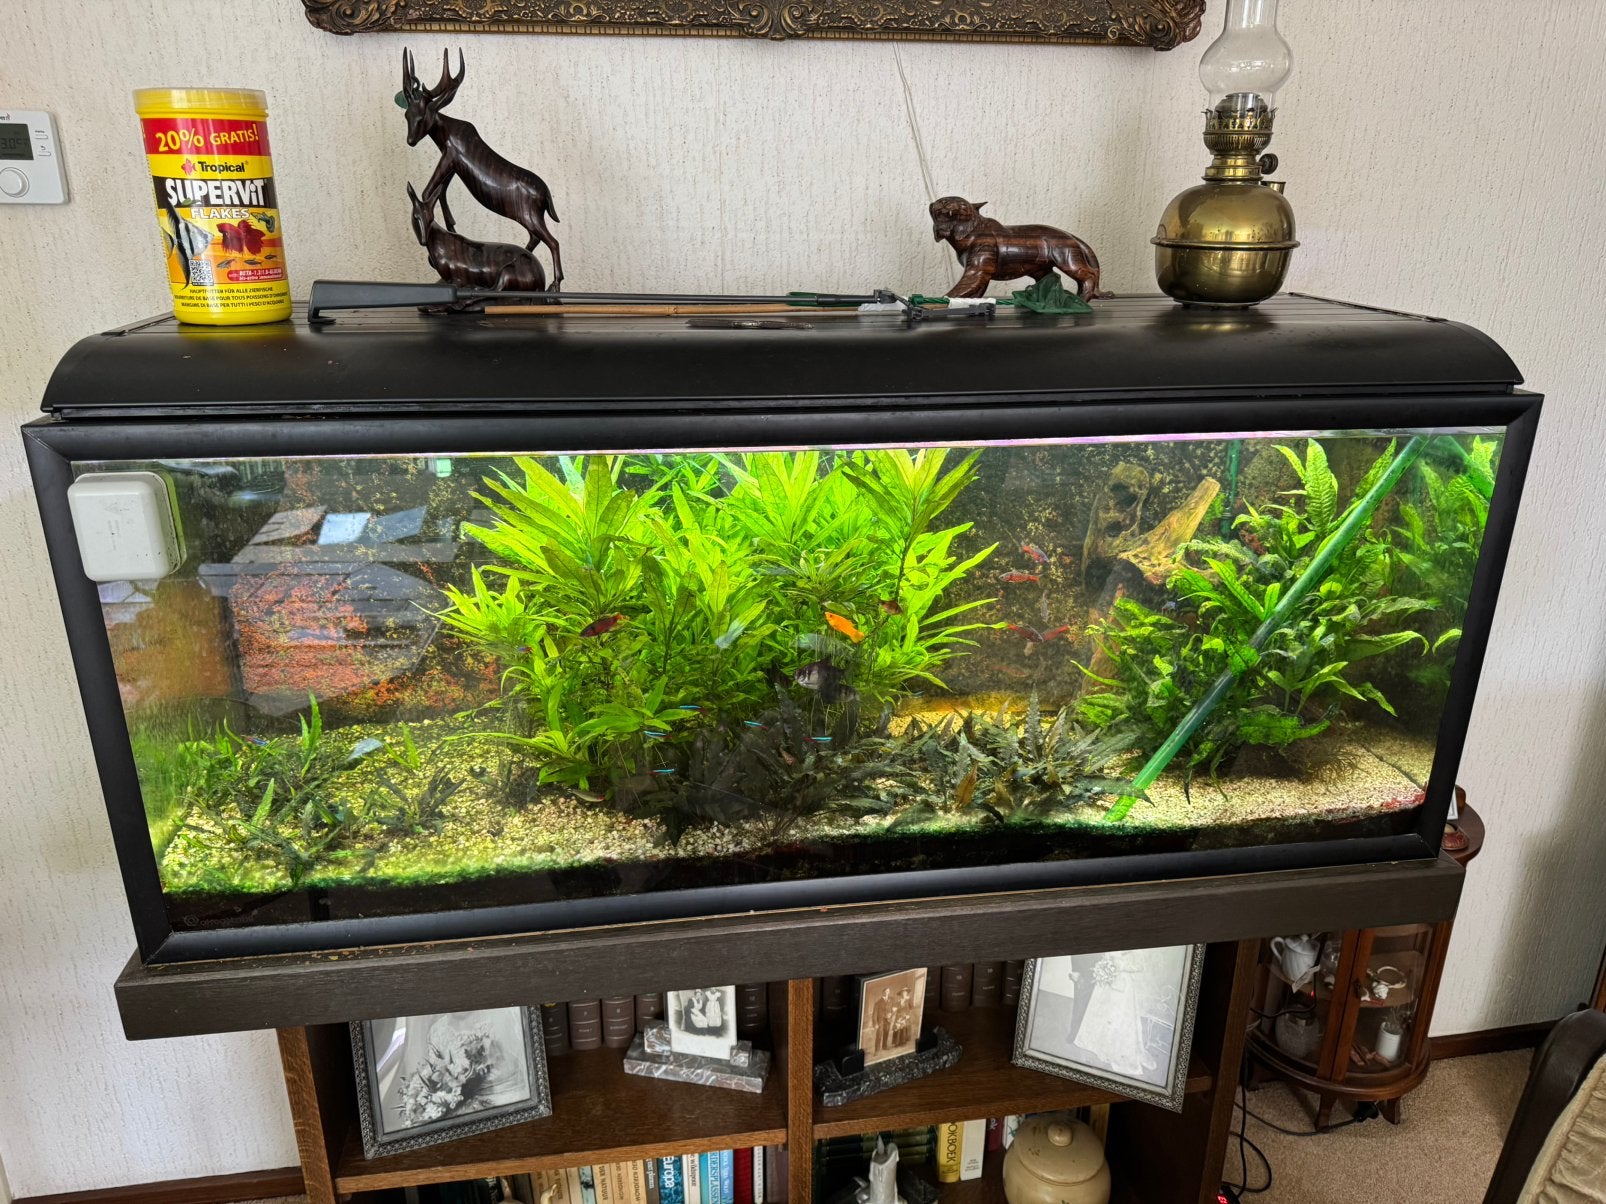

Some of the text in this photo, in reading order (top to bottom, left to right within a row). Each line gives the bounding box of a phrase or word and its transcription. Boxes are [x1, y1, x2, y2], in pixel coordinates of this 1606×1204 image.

[155, 123, 259, 152] 20% GRATIS!
[198, 161, 246, 174] Tropical
[191, 208, 251, 219] FLAKES
